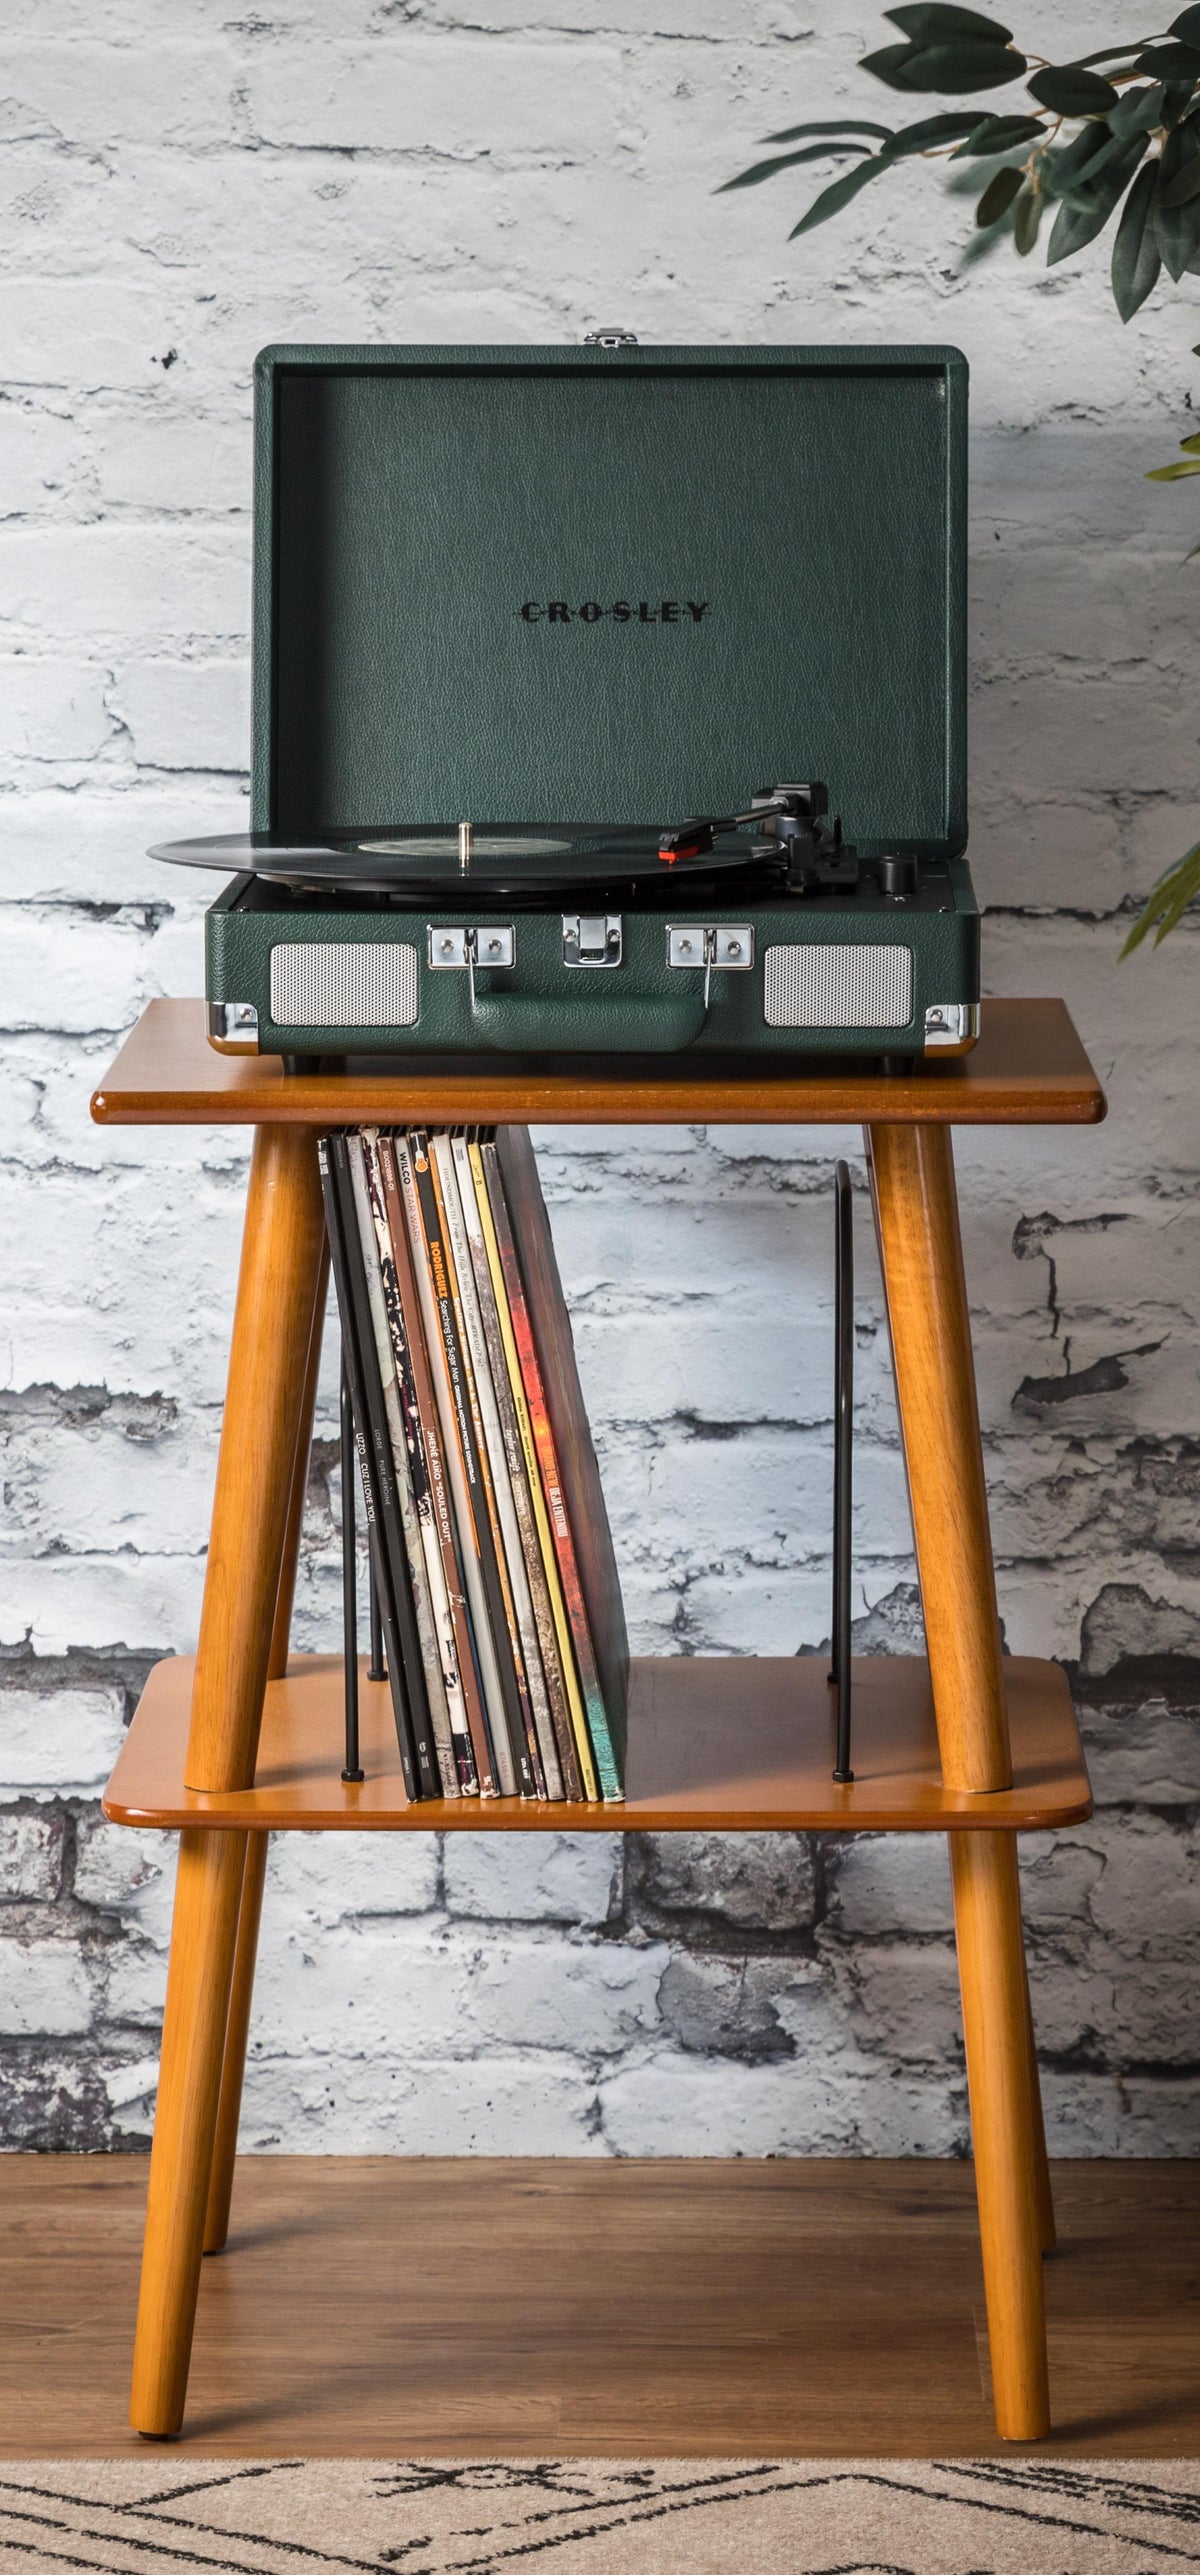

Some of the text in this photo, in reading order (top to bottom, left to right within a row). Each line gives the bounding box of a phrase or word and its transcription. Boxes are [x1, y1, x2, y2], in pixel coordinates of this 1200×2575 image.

[516, 601, 711, 623] CROSLEY
[399, 1152, 421, 1243] WILCO STAR WARS
[431, 1241, 447, 1298] RODRIGUEZ
[440, 1299, 452, 1333] Searching
[446, 1334, 455, 1345] For
[447, 1346, 458, 1366] Sugar
[452, 1367, 461, 1382] Man
[356, 1432, 366, 1454] LIZZO
[427, 1429, 439, 1457] JHENÉ
[504, 1428, 516, 1449] taylor
[361, 1462, 370, 1478] CUZ
[375, 1429, 392, 1504] LORDE PURE HEROINE
[466, 1450, 477, 1483] SOUNDTRACK
[508, 1450, 520, 1472] swift
[364, 1484, 373, 1503] LOVE
[549, 1486, 562, 1505] DEJA
[367, 1505, 376, 1521] YOU
[553, 1505, 568, 1537] ENTENDU
